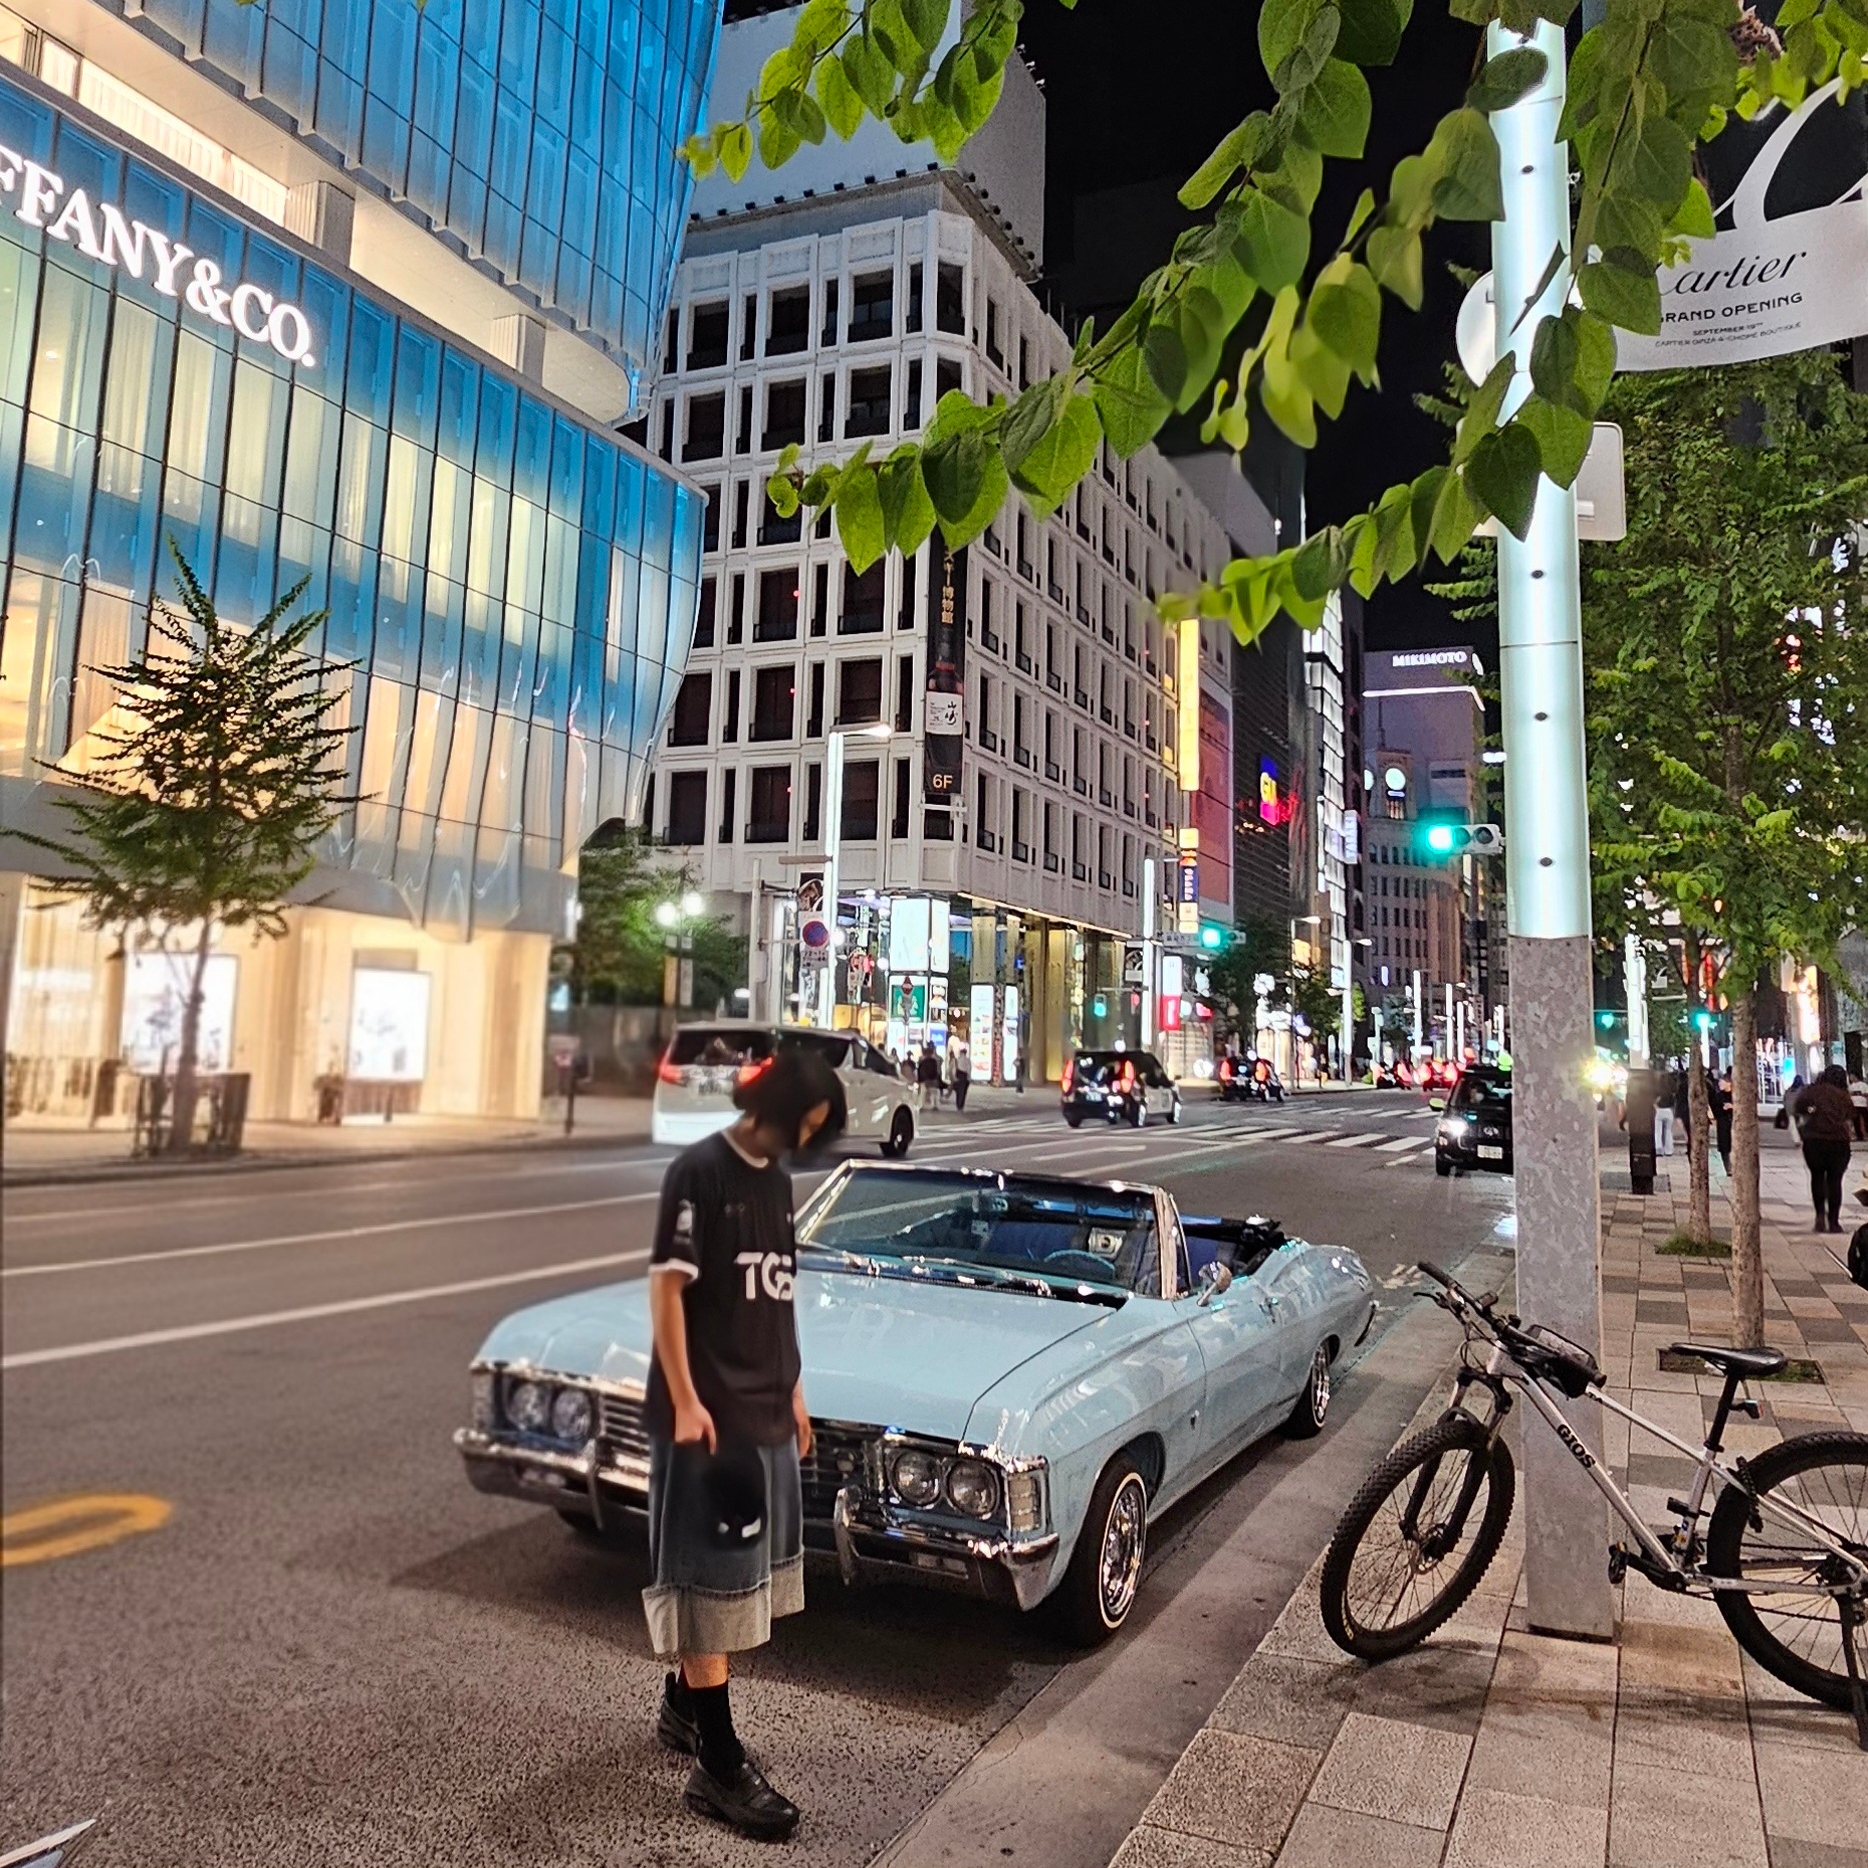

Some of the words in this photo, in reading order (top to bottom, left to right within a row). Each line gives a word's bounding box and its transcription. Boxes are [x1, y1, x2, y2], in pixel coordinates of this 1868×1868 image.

[1658, 251, 1808, 296] artier
[1660, 308, 1715, 324] RAND
[1721, 292, 1803, 318] OPENING
[1692, 325, 1745, 336] SEPTEMBER
[1392, 651, 1468, 667] MIKIMOTO
[932, 773, 953, 789] 6F
[1556, 1424, 1597, 1468] GIOS
